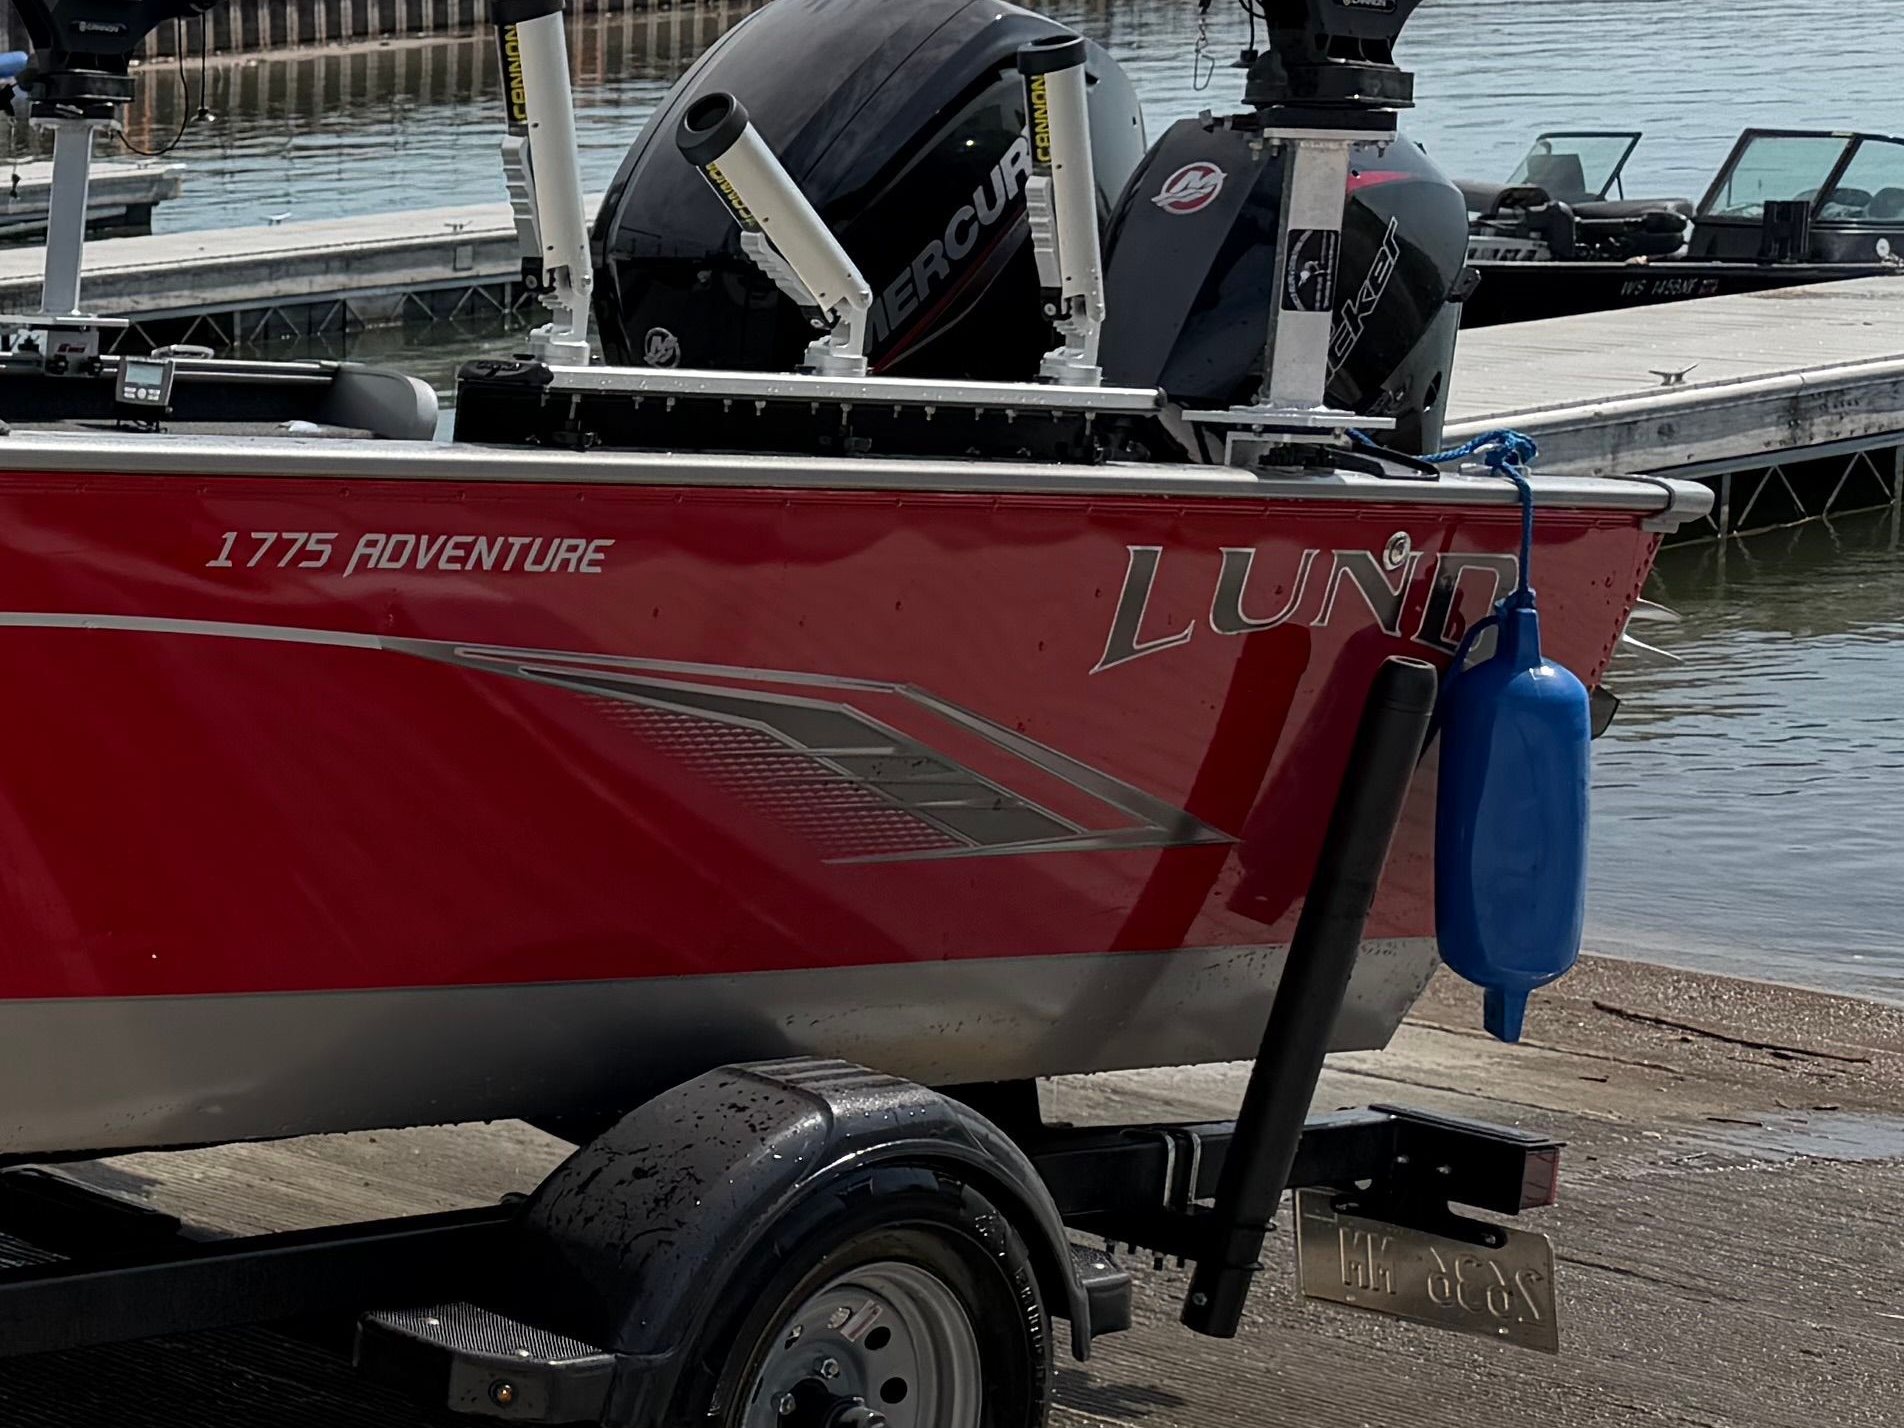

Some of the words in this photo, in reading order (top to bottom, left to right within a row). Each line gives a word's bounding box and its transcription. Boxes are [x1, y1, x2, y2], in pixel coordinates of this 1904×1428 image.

[863, 122, 1032, 355] MERCUR
[205, 531, 340, 568] 1775
[342, 532, 616, 579] ADVENTURE
[1089, 544, 1524, 675] LUND
